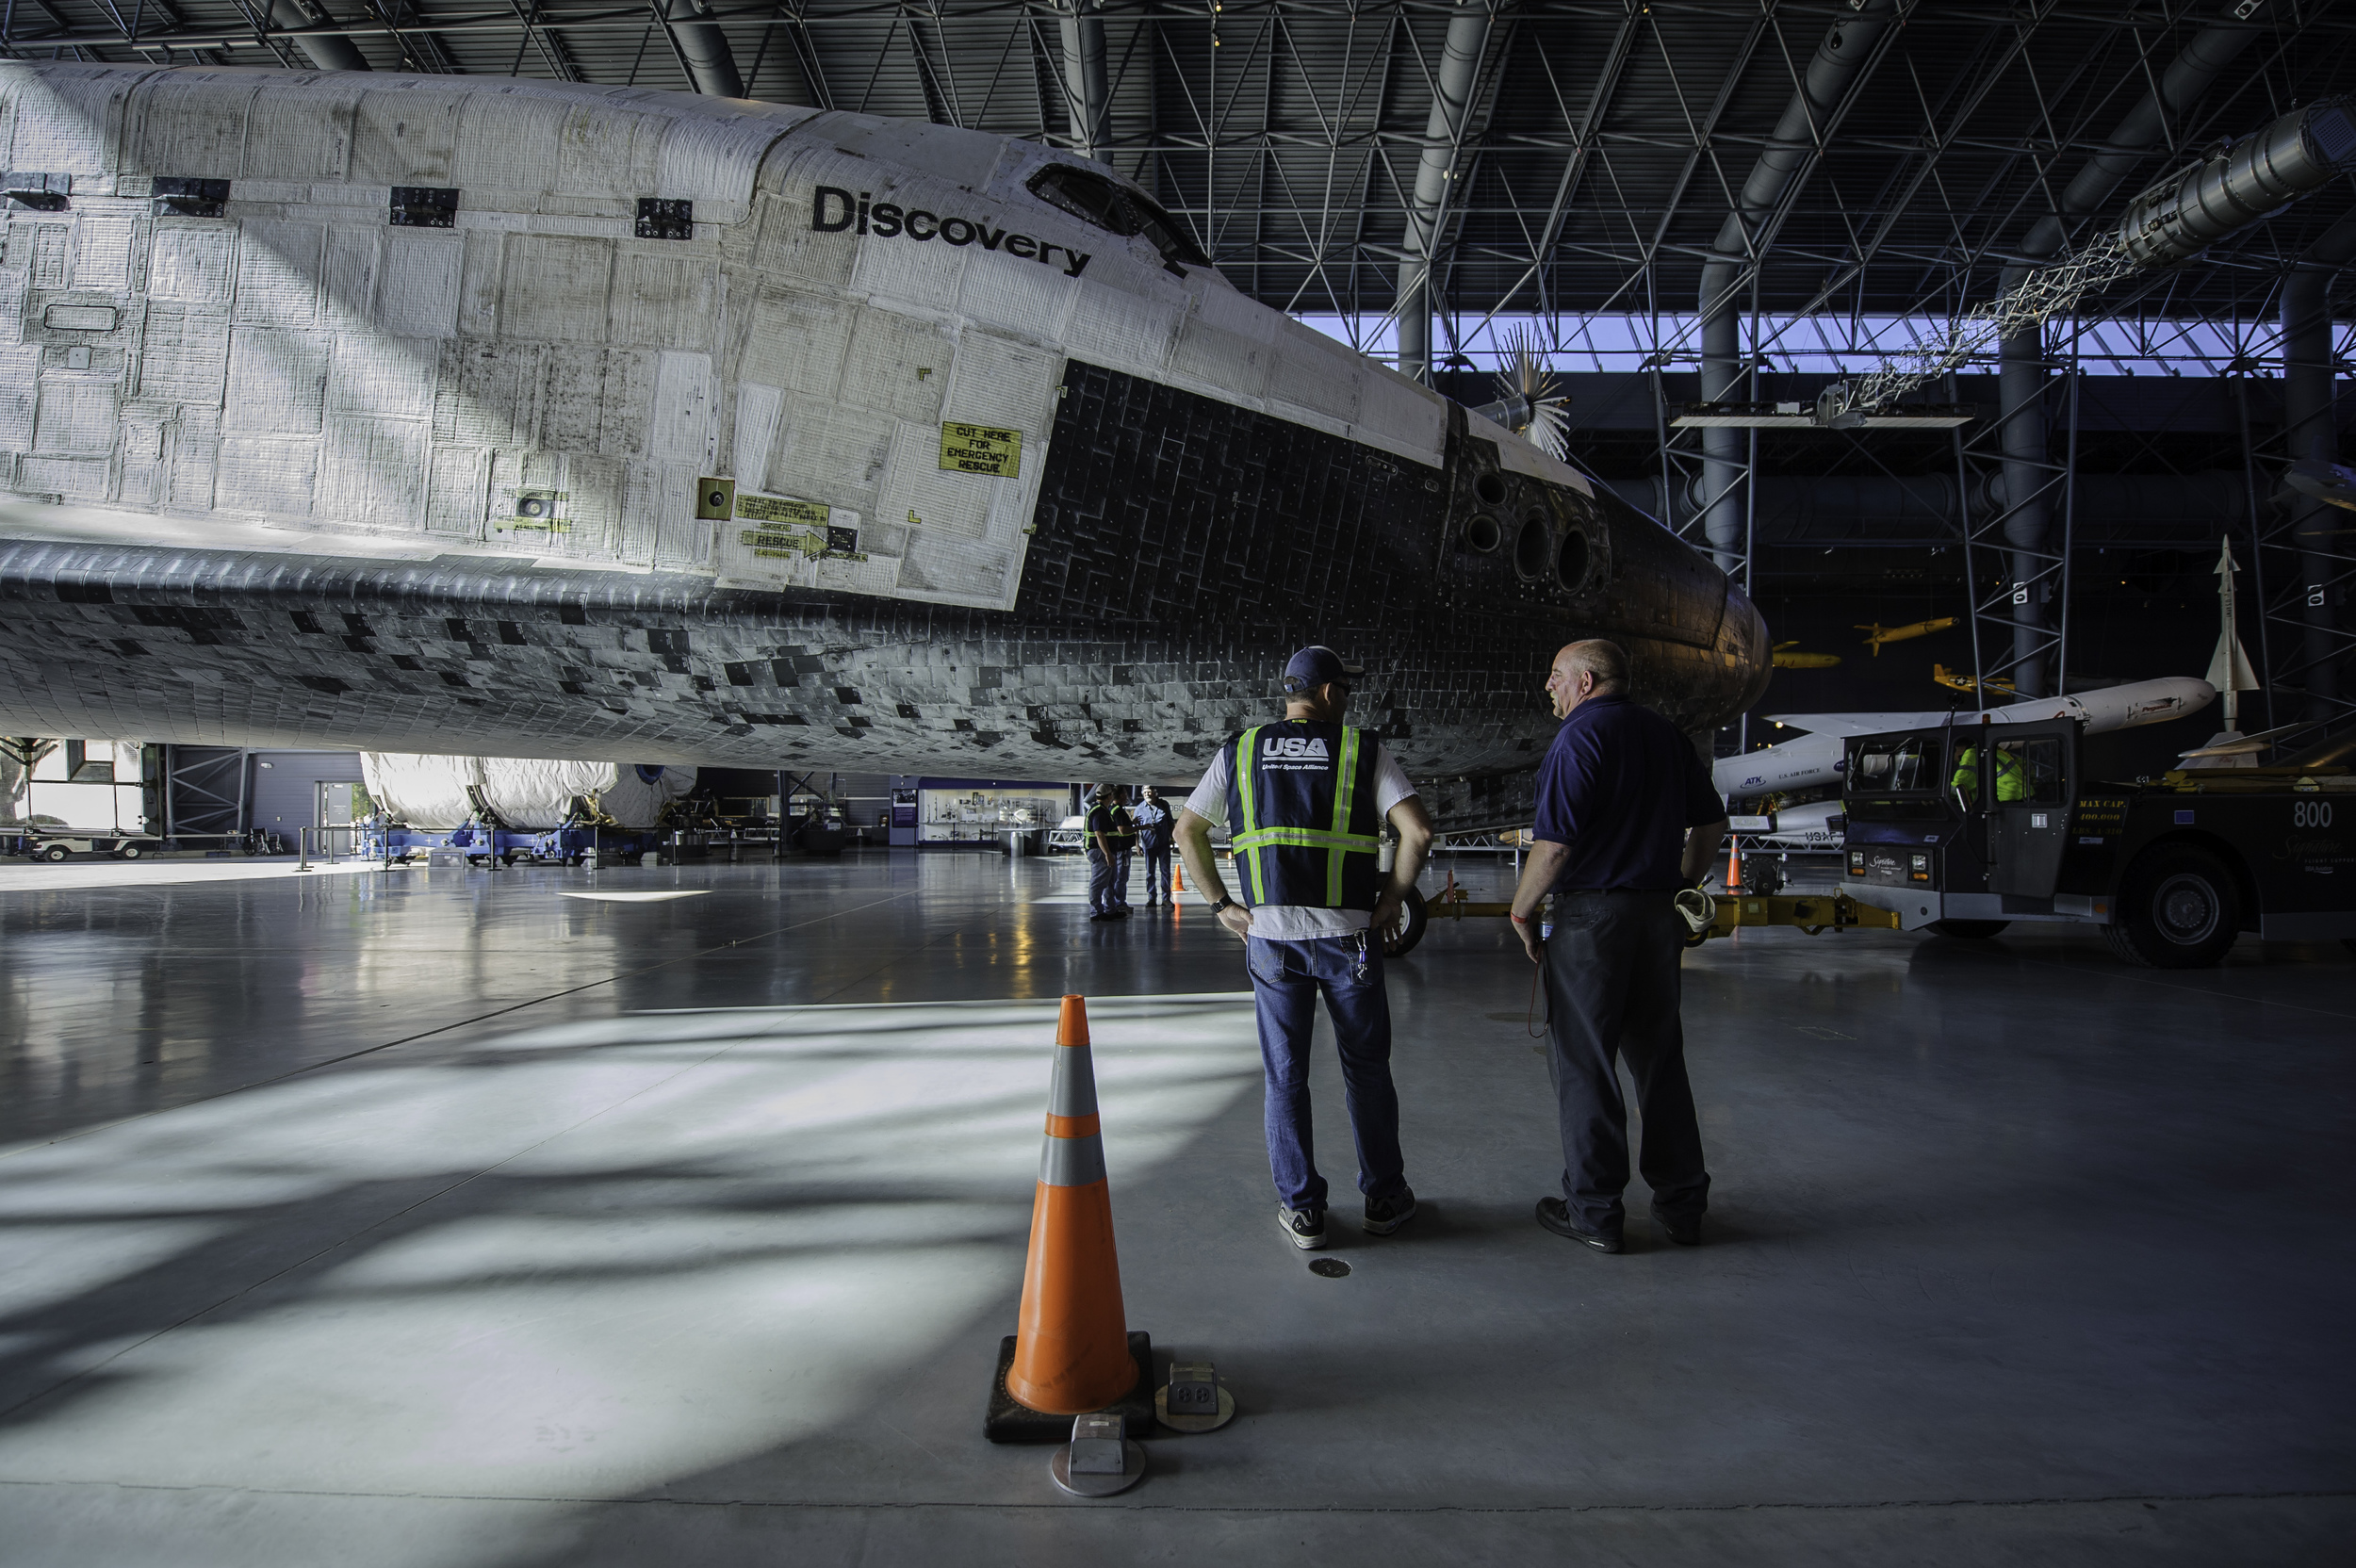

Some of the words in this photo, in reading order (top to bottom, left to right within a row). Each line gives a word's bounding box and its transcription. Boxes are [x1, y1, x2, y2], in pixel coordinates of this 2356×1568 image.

[811, 186, 1091, 278] Discovery
[956, 427, 976, 437] CUT
[984, 430, 1011, 442] HERE
[969, 439, 990, 449] FOR
[947, 448, 1009, 463] EMERGENCY
[958, 460, 1001, 473] RESCUE
[757, 535, 800, 548] RESCUE
[1263, 738, 1329, 757] USA
[1744, 776, 1762, 786] ATK
[2294, 801, 2332, 827] 800
